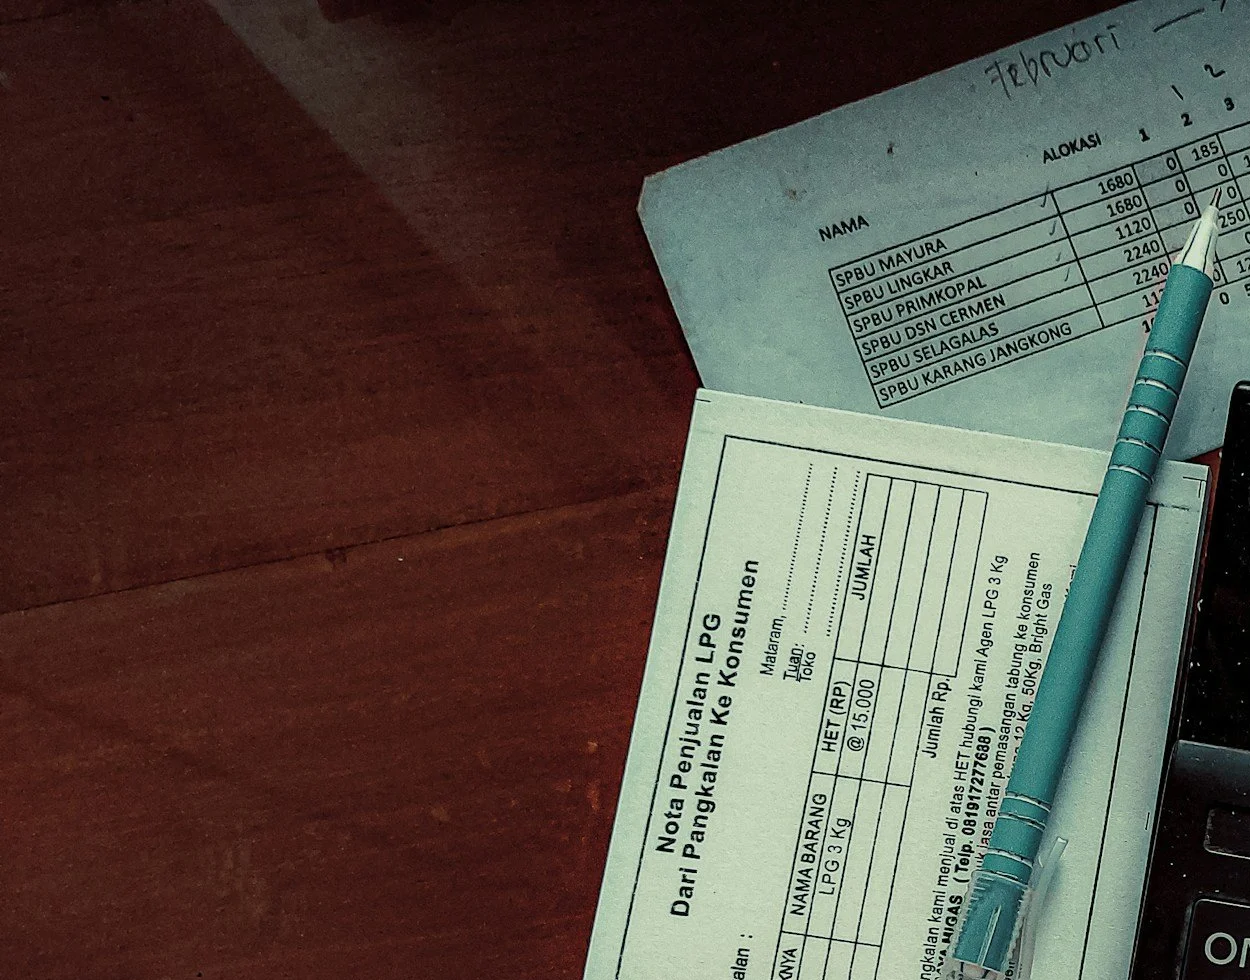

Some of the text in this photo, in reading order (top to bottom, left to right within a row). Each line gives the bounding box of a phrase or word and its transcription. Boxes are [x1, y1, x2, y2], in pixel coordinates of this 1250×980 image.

[818, 132, 1102, 242] NAMA ALOKASI
[835, 172, 1134, 287] SPBU MAYURA 1680
[844, 194, 1143, 310] SPBU LINGKAR 1680
[853, 216, 1152, 333] SPBU PRIMKOPAL 1120
[861, 239, 1160, 356] SPBU DSN CERMEN 2240
[870, 262, 1169, 379] SPBU SELAGALAS 2240
[879, 322, 1072, 402] SPBU KARANG JANGKONG
[851, 534, 876, 601] JUMLAH
[987, 577, 1001, 586] 3
[989, 555, 1009, 573] Kg
[1016, 552, 1041, 621] konsumen
[981, 589, 999, 619] LPG
[1036, 583, 1053, 610] Gas
[759, 615, 787, 676] Mataram,
[975, 622, 994, 658] Agen
[1013, 624, 1028, 640] ke
[1024, 613, 1048, 654] Bright
[798, 651, 817, 683] Toko
[968, 659, 987, 692] kami
[1004, 643, 1028, 689] tabung
[1021, 658, 1042, 698] 50Kg,
[828, 680, 852, 715] (RP)
[921, 678, 953, 759] Jumlah Rp.
[655, 613, 721, 853] Nota Penjualan LPG
[669, 560, 759, 917] Dari Pangkalan Ke Konsumen
[821, 718, 841, 753] HET
[958, 694, 984, 749] hubungi
[992, 693, 1020, 780] pemasangan
[818, 679, 875, 895] LPG 3 Kg @ 15.000
[953, 750, 971, 782] HET
[945, 816, 959, 830] di
[949, 785, 965, 815] atas
[985, 781, 1001, 818] antar
[800, 793, 827, 864] BARANG
[937, 833, 960, 887] menjual
[953, 840, 980, 877] Telp.
[789, 867, 814, 916] NAMA
[926, 890, 946, 923] kami
